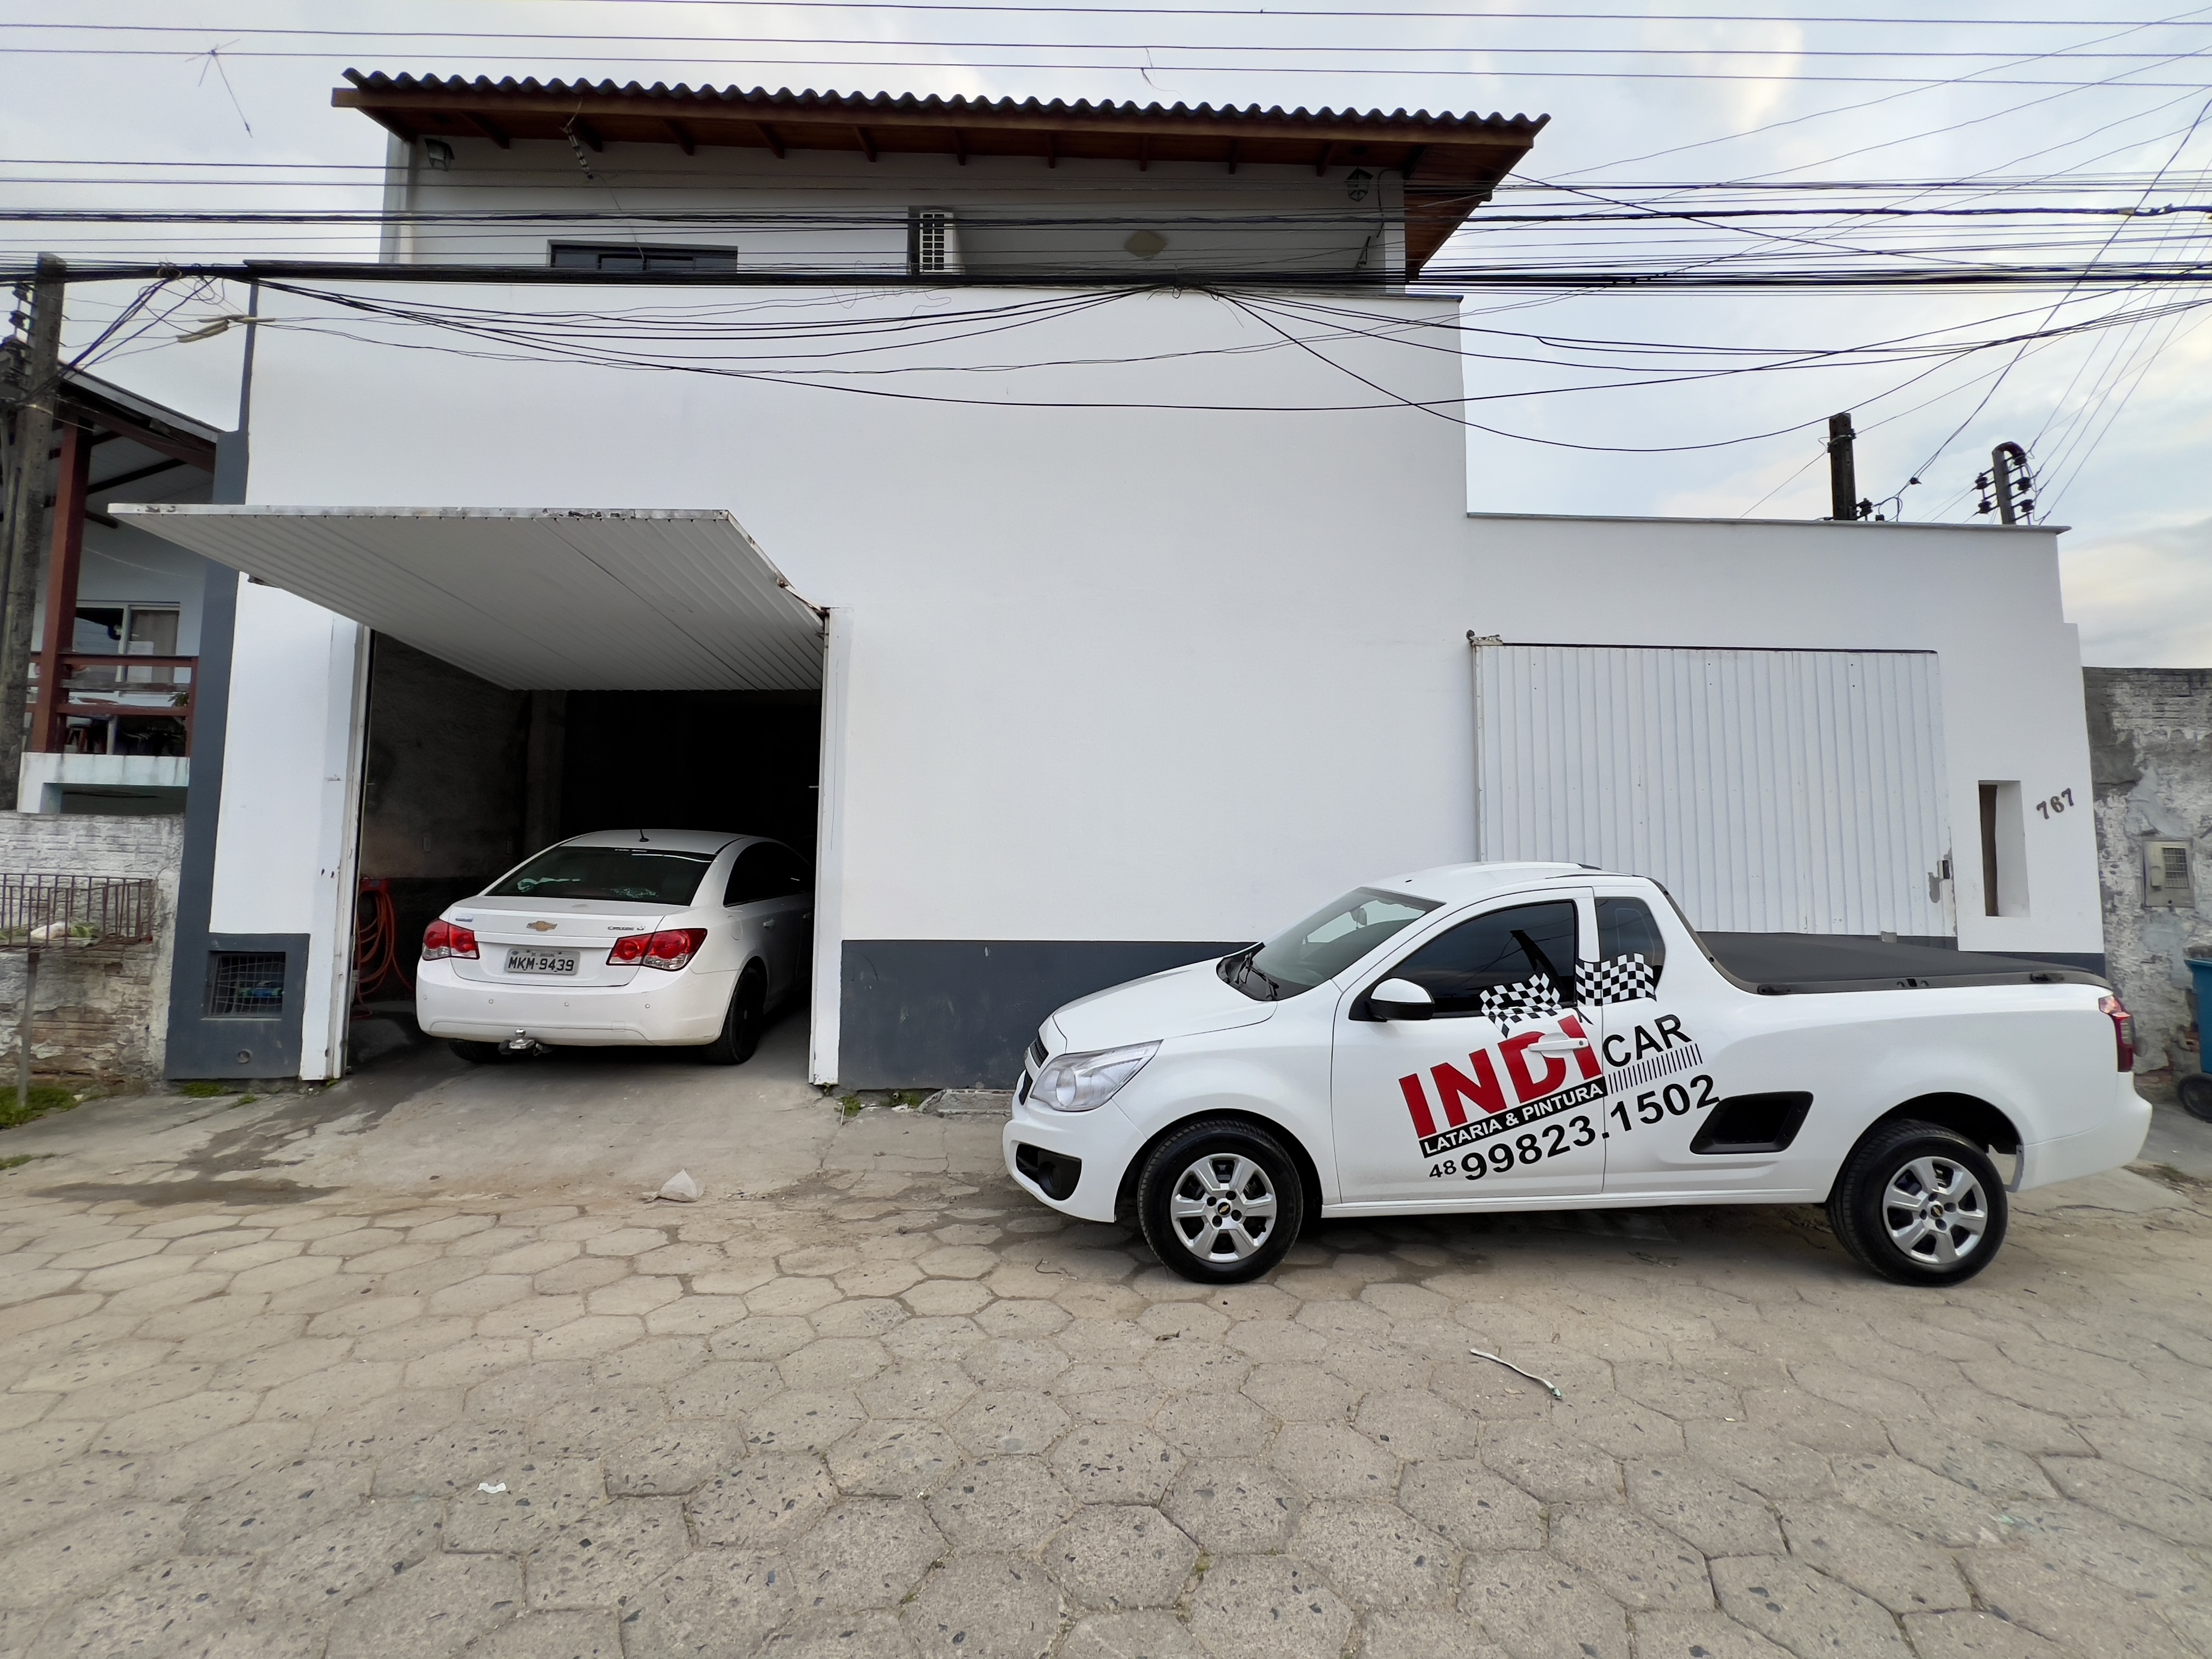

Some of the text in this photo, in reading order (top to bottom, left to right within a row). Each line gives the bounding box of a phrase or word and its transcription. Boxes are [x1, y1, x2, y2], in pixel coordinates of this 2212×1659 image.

[2036, 787, 2074, 820] 767
[1398, 1014, 1692, 1139] INDI CAR
[1424, 1082, 1604, 1154] LATARIA & PINTURA
[1429, 1074, 1720, 1181] 48 99823.1502
